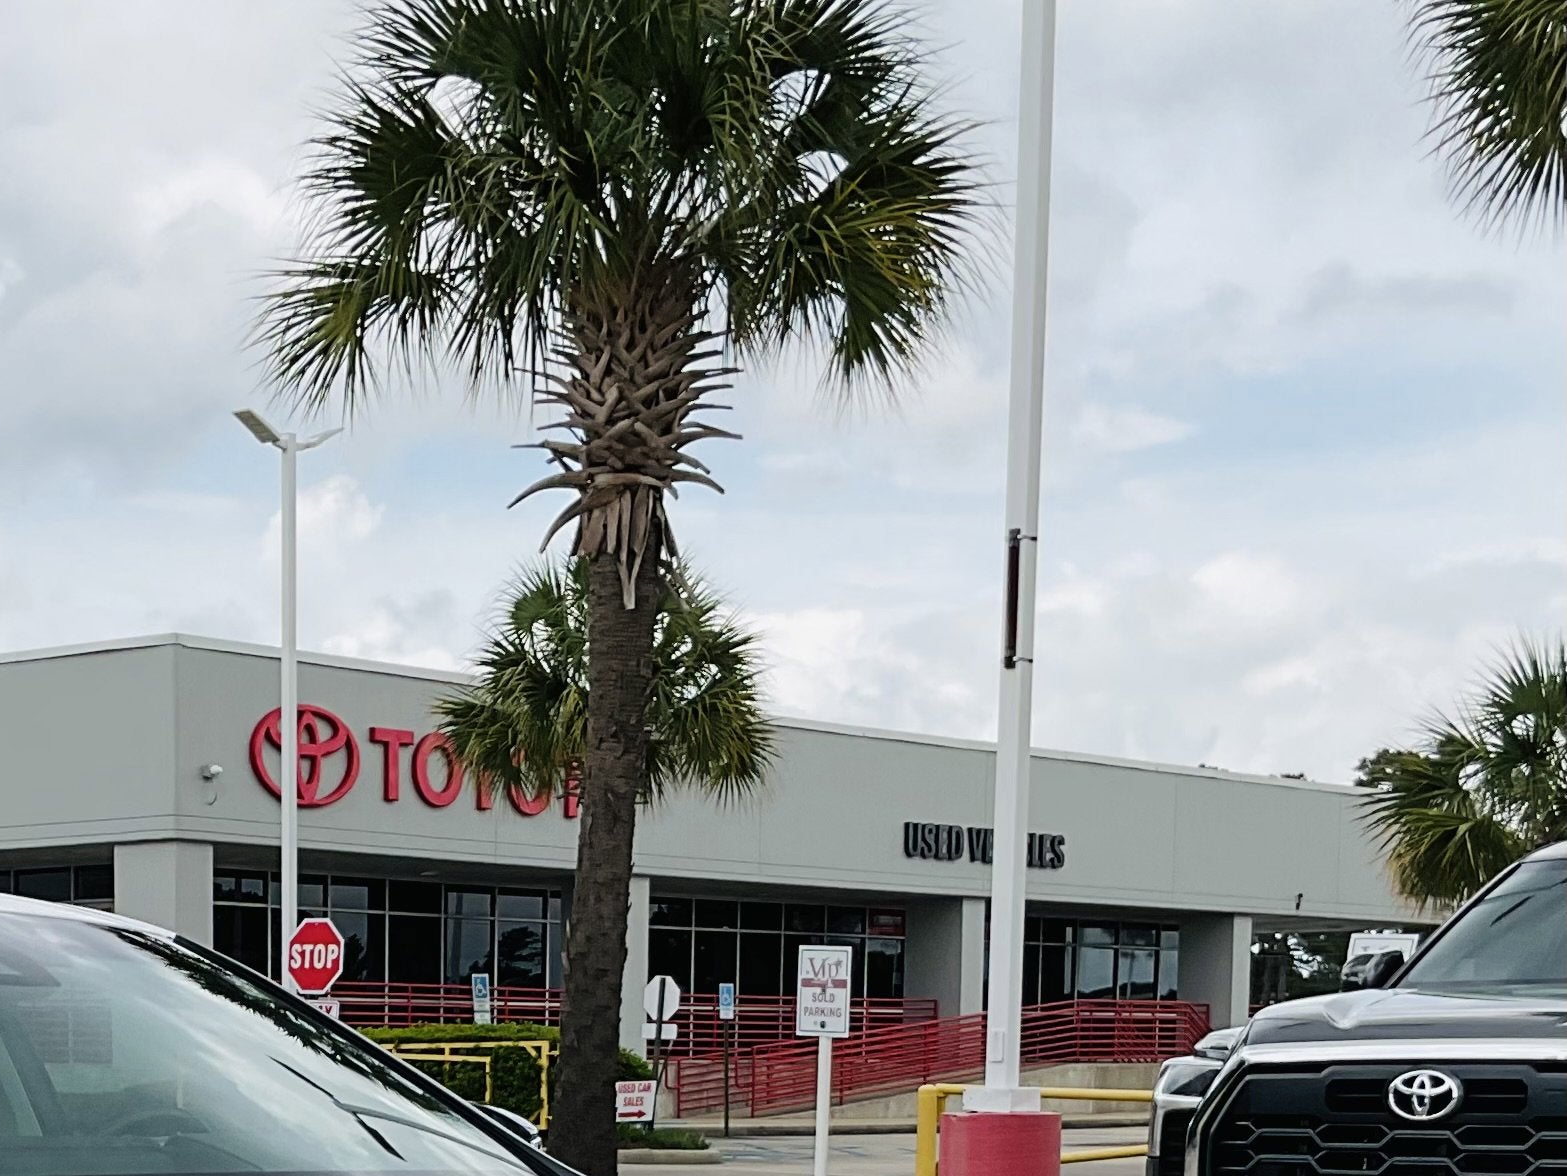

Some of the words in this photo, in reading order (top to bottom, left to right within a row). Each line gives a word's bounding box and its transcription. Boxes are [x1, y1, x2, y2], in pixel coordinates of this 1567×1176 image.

[904, 822, 964, 861] USED
[967, 827, 1065, 869] VELES
[290, 943, 339, 969] STOP
[812, 993, 835, 1003] SOLD
[803, 1006, 842, 1017] PARKING
[618, 1083, 636, 1093] USED
[638, 1082, 651, 1093] CAR
[623, 1096, 644, 1107] SALES
